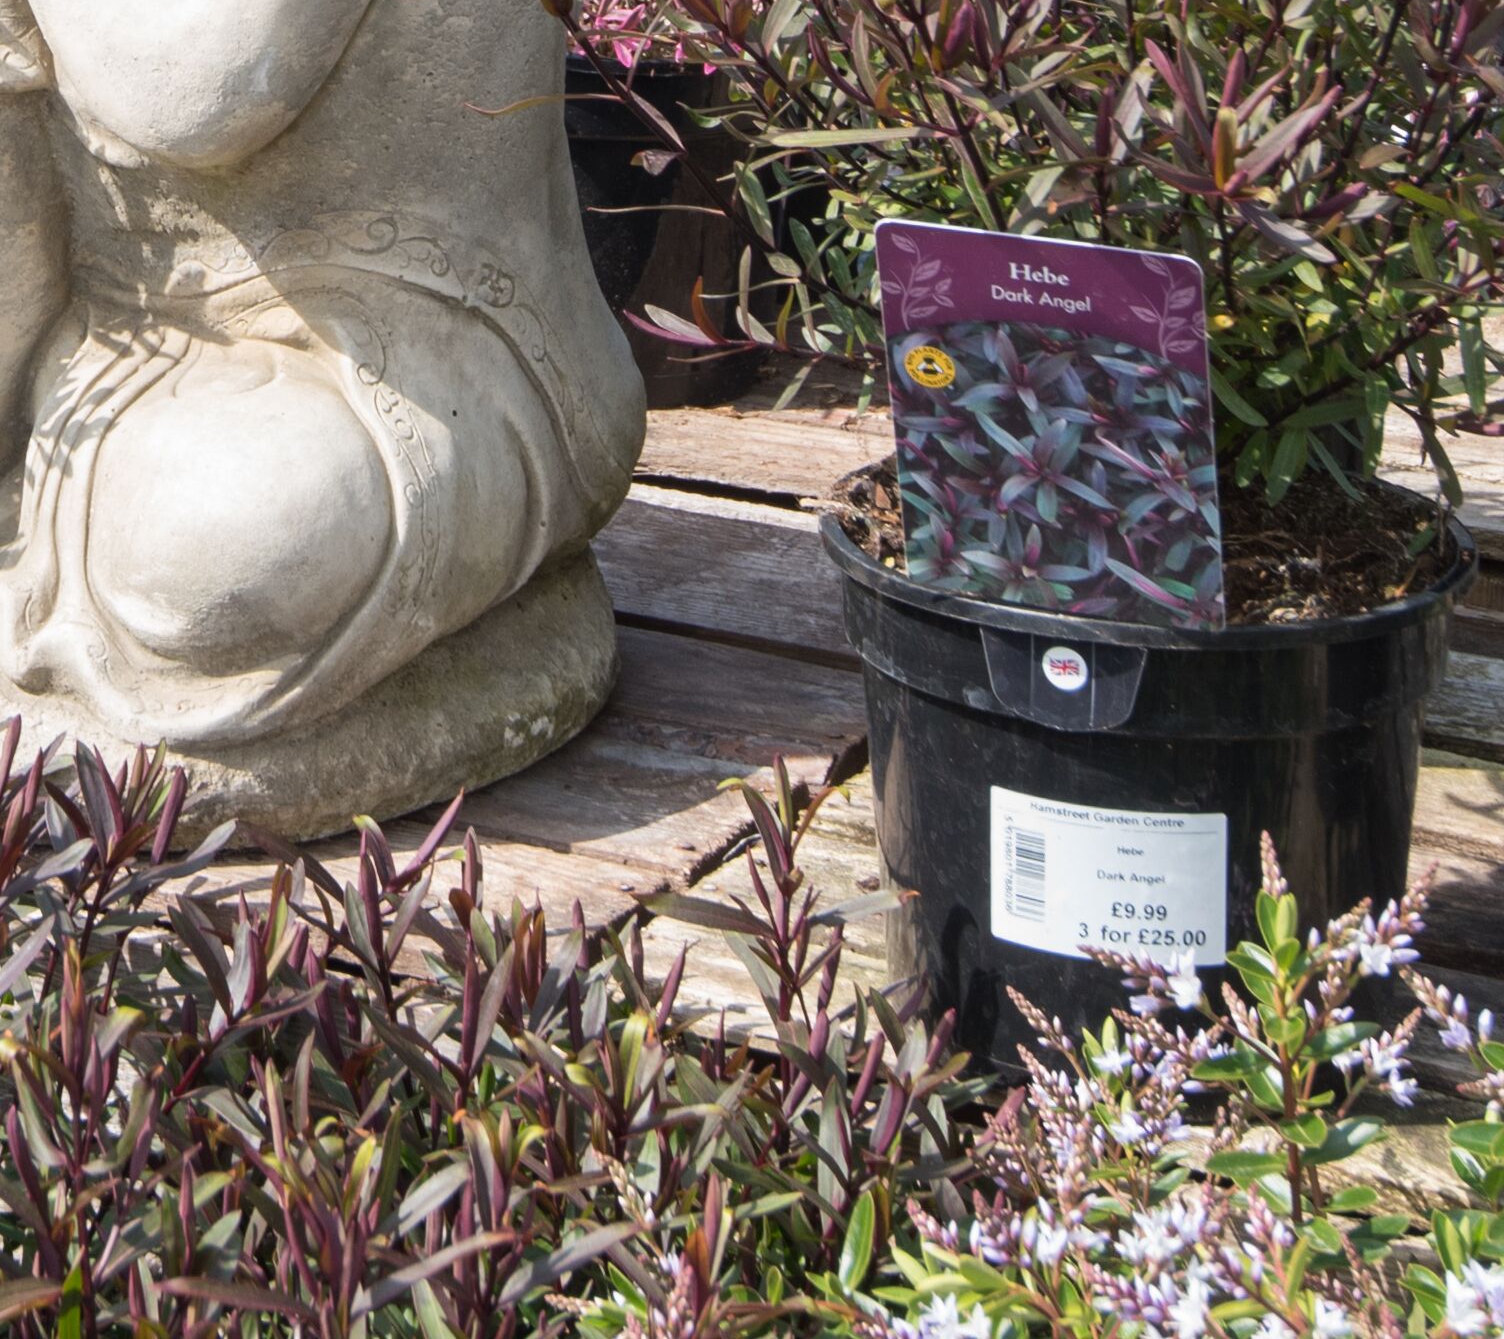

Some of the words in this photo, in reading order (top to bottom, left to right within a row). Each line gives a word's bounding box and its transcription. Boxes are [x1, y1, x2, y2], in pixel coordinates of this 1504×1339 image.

[1008, 262, 1071, 286] Hebe
[991, 284, 1034, 305] Dark
[1039, 291, 1091, 314] Angel
[1093, 811, 1139, 827] Garden
[1143, 816, 1185, 829] Centre
[1117, 846, 1145, 857] Hebe
[1097, 869, 1126, 882] Dark
[1130, 873, 1166, 886] Angel
[1112, 902, 1168, 921] £9.99
[1078, 922, 1090, 939] 3
[1100, 925, 1131, 944] for
[1138, 929, 1207, 947] £25.00
